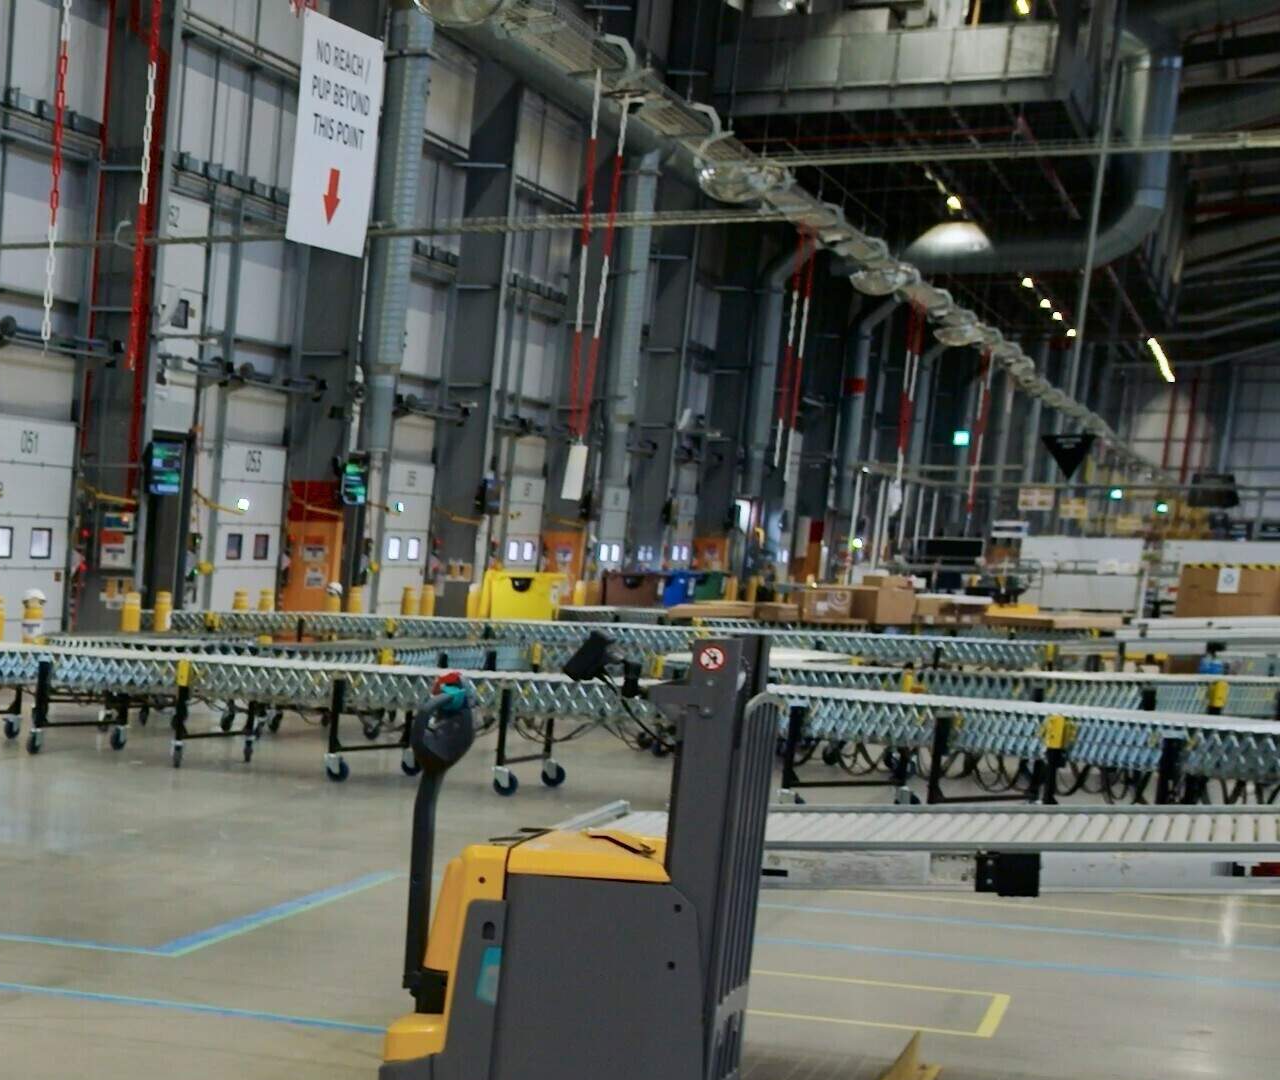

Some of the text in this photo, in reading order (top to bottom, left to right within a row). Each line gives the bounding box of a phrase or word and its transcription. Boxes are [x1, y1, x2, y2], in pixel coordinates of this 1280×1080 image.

[317, 39, 331, 65] NO
[334, 46, 363, 79] REACH
[312, 74, 370, 116] PUP BEYOND
[313, 112, 364, 151] THIS POINT
